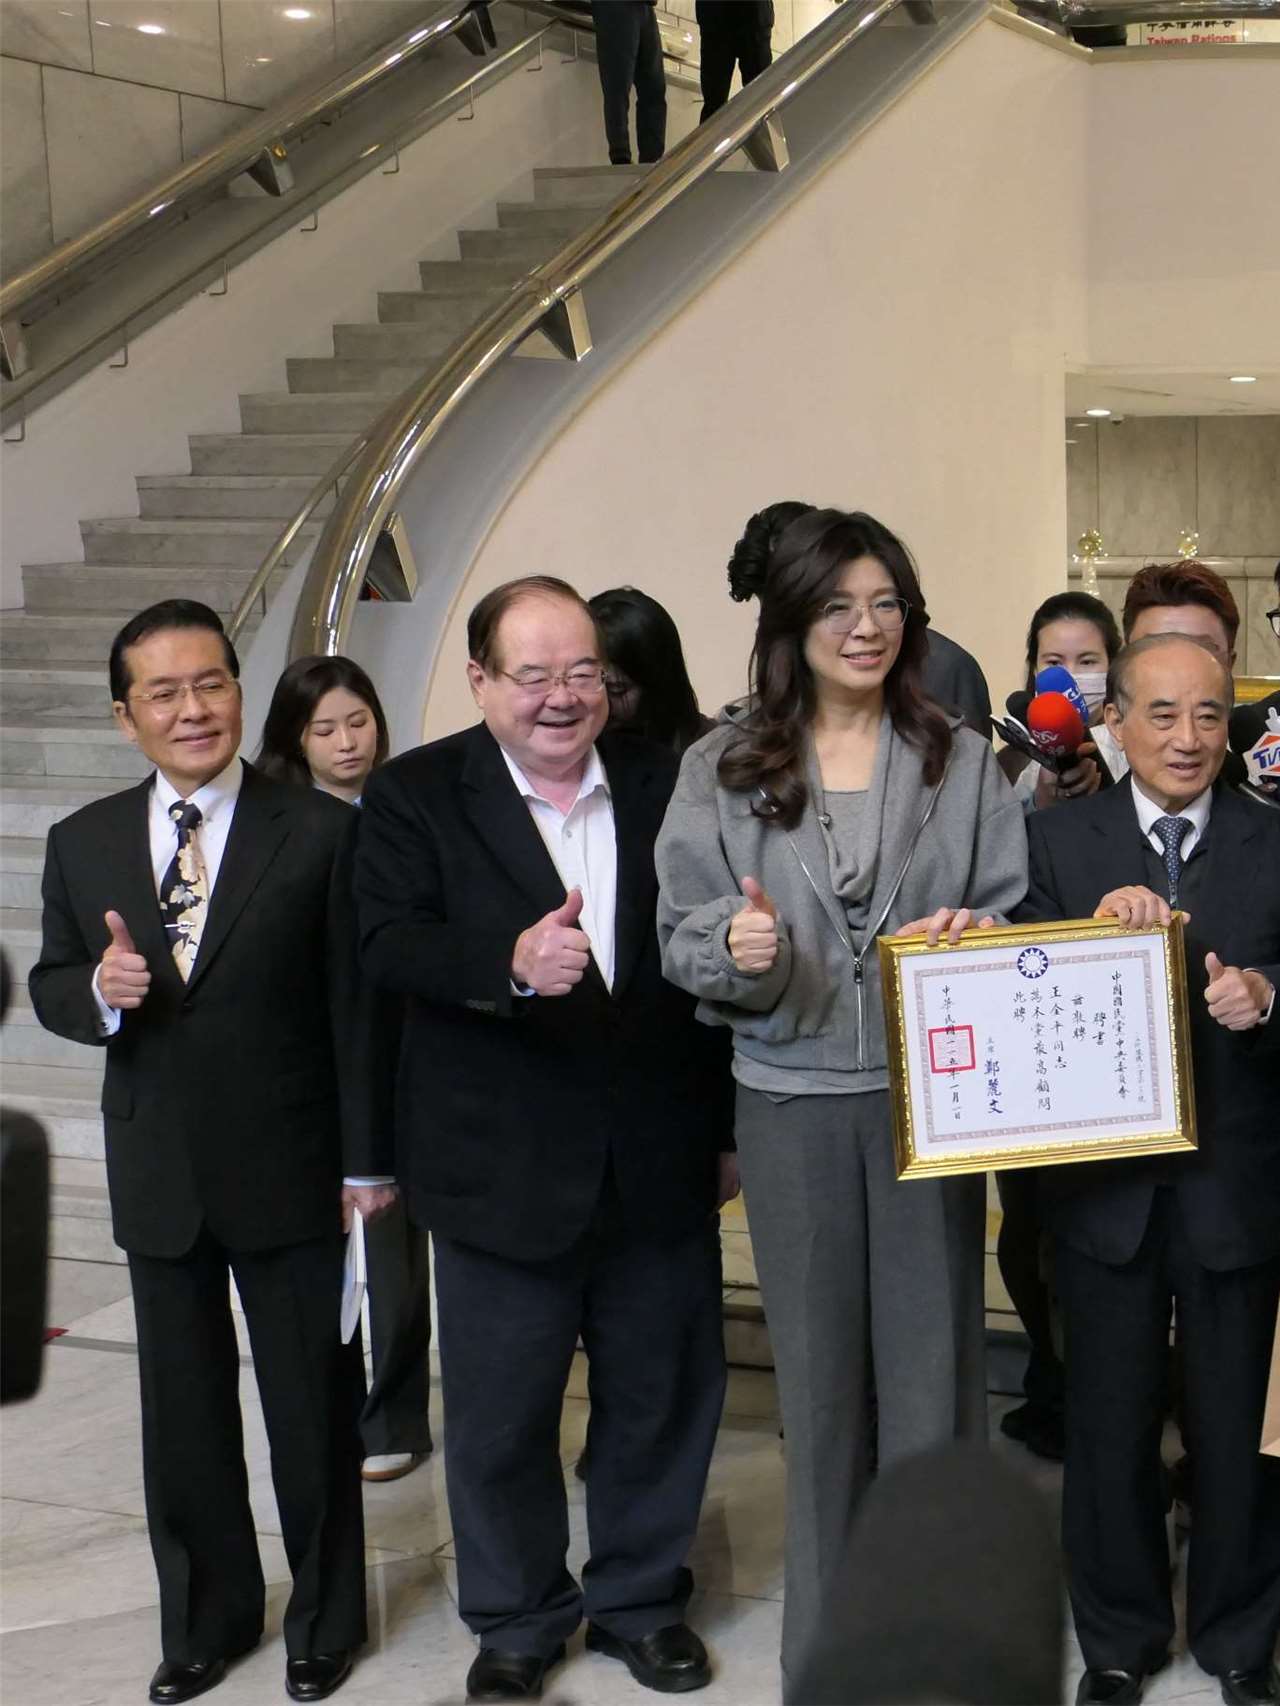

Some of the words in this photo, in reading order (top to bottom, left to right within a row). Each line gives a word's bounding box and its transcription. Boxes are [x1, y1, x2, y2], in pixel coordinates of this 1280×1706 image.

[1147, 36, 1188, 45] Taiwan
[1191, 34, 1237, 43] Ratings
[1013, 991, 1027, 1023] 此聘
[1050, 986, 1068, 1069] 王金平同志
[1092, 1012, 1107, 1047] 聘書
